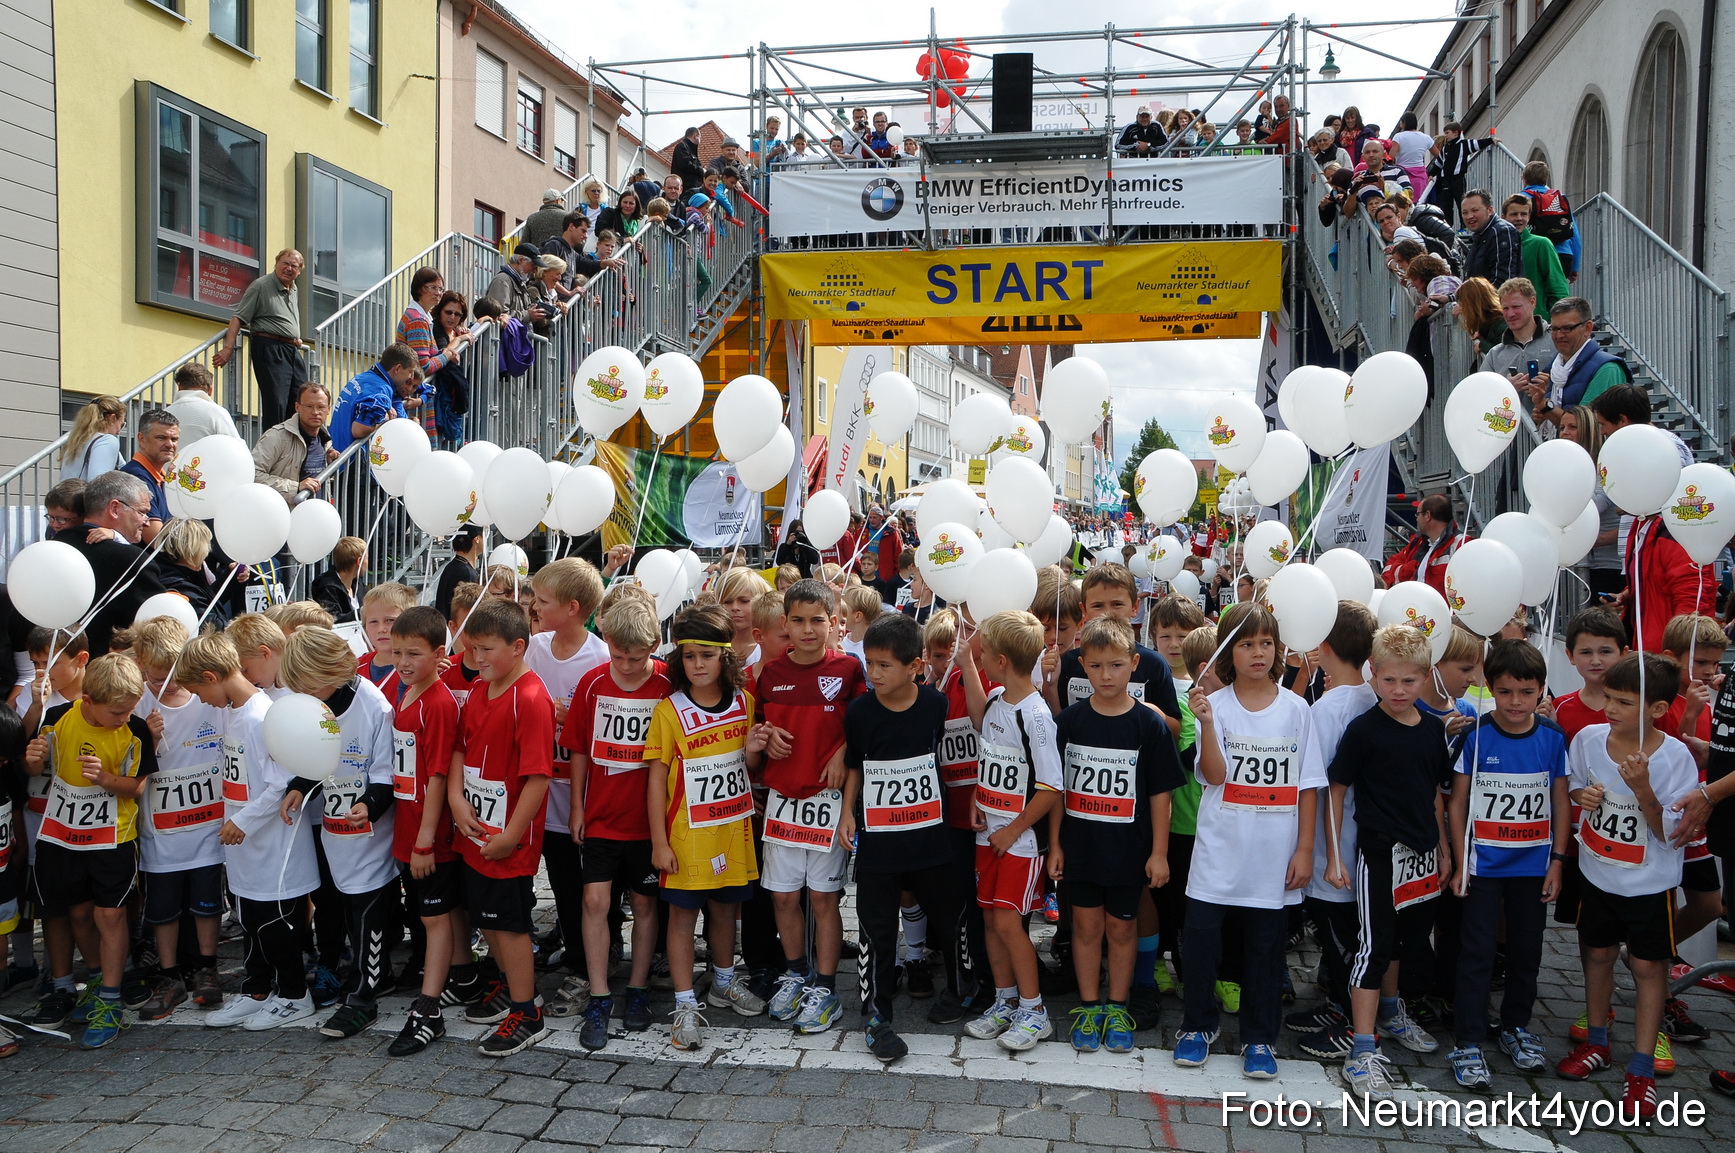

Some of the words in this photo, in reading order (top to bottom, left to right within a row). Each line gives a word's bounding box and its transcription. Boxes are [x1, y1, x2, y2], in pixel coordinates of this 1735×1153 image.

[866, 179, 900, 192] BMW
[915, 179, 974, 199] BMW
[980, 173, 1184, 198] EfficientDynamics
[916, 201, 975, 216] Weniger
[978, 199, 1056, 214] Verbrauch.
[1060, 197, 1098, 211] Mehr
[1101, 196, 1185, 210] Fahrfreude.
[926, 259, 1104, 305] START
[1136, 280, 1198, 291] Neumarkter
[1201, 279, 1250, 290] Stadtlauf
[787, 287, 847, 297] Neumarkter
[849, 286, 897, 297] Stadtlauf
[845, 403, 862, 441] BKK
[835, 443, 851, 487] Audi
[1069, 684, 1093, 694] PARTL
[598, 701, 617, 712] PARTL
[618, 705, 652, 714] Neumarkt
[602, 713, 652, 742] 7092
[945, 725, 970, 734] Neumarkt
[686, 732, 720, 751] MAX
[1227, 741, 1250, 752] PARTL
[1251, 744, 1289, 753] Neumarkt
[607, 746, 644, 760] Bastian
[982, 747, 1016, 762] Neumarkt
[1066, 750, 1086, 761] PARTL
[1087, 755, 1126, 765] Neumarkt
[224, 755, 240, 782] 95
[686, 764, 713, 774] PARTL
[713, 758, 741, 770] Neumarkt
[866, 767, 889, 776] PARTL
[890, 763, 926, 775] Neumarkt
[979, 758, 1019, 791] 108
[1232, 754, 1290, 785] 7391
[150, 776, 173, 785] PARTL
[175, 770, 209, 782] Neumarkt
[694, 767, 746, 802] 7283
[1070, 764, 1129, 797] 7205
[1475, 779, 1503, 789] PARTL
[1505, 780, 1542, 789] Neumarkt
[53, 782, 70, 799] PARTL
[71, 790, 107, 800] Neumarkt
[156, 778, 214, 810] 7101
[871, 774, 933, 806] 7238
[55, 794, 109, 826] 7124
[323, 793, 358, 817] 27
[709, 800, 744, 818] Samuel
[775, 794, 832, 828] 7166
[1079, 798, 1112, 813] Robin
[1483, 793, 1544, 821] 7242
[175, 810, 206, 825] Jonas
[888, 809, 922, 823] Julian
[323, 819, 357, 833] nathan
[771, 823, 826, 844] Maximilian
[1498, 826, 1534, 839] Marco
[65, 831, 86, 843] Jan
[1397, 848, 1435, 885] 7388
